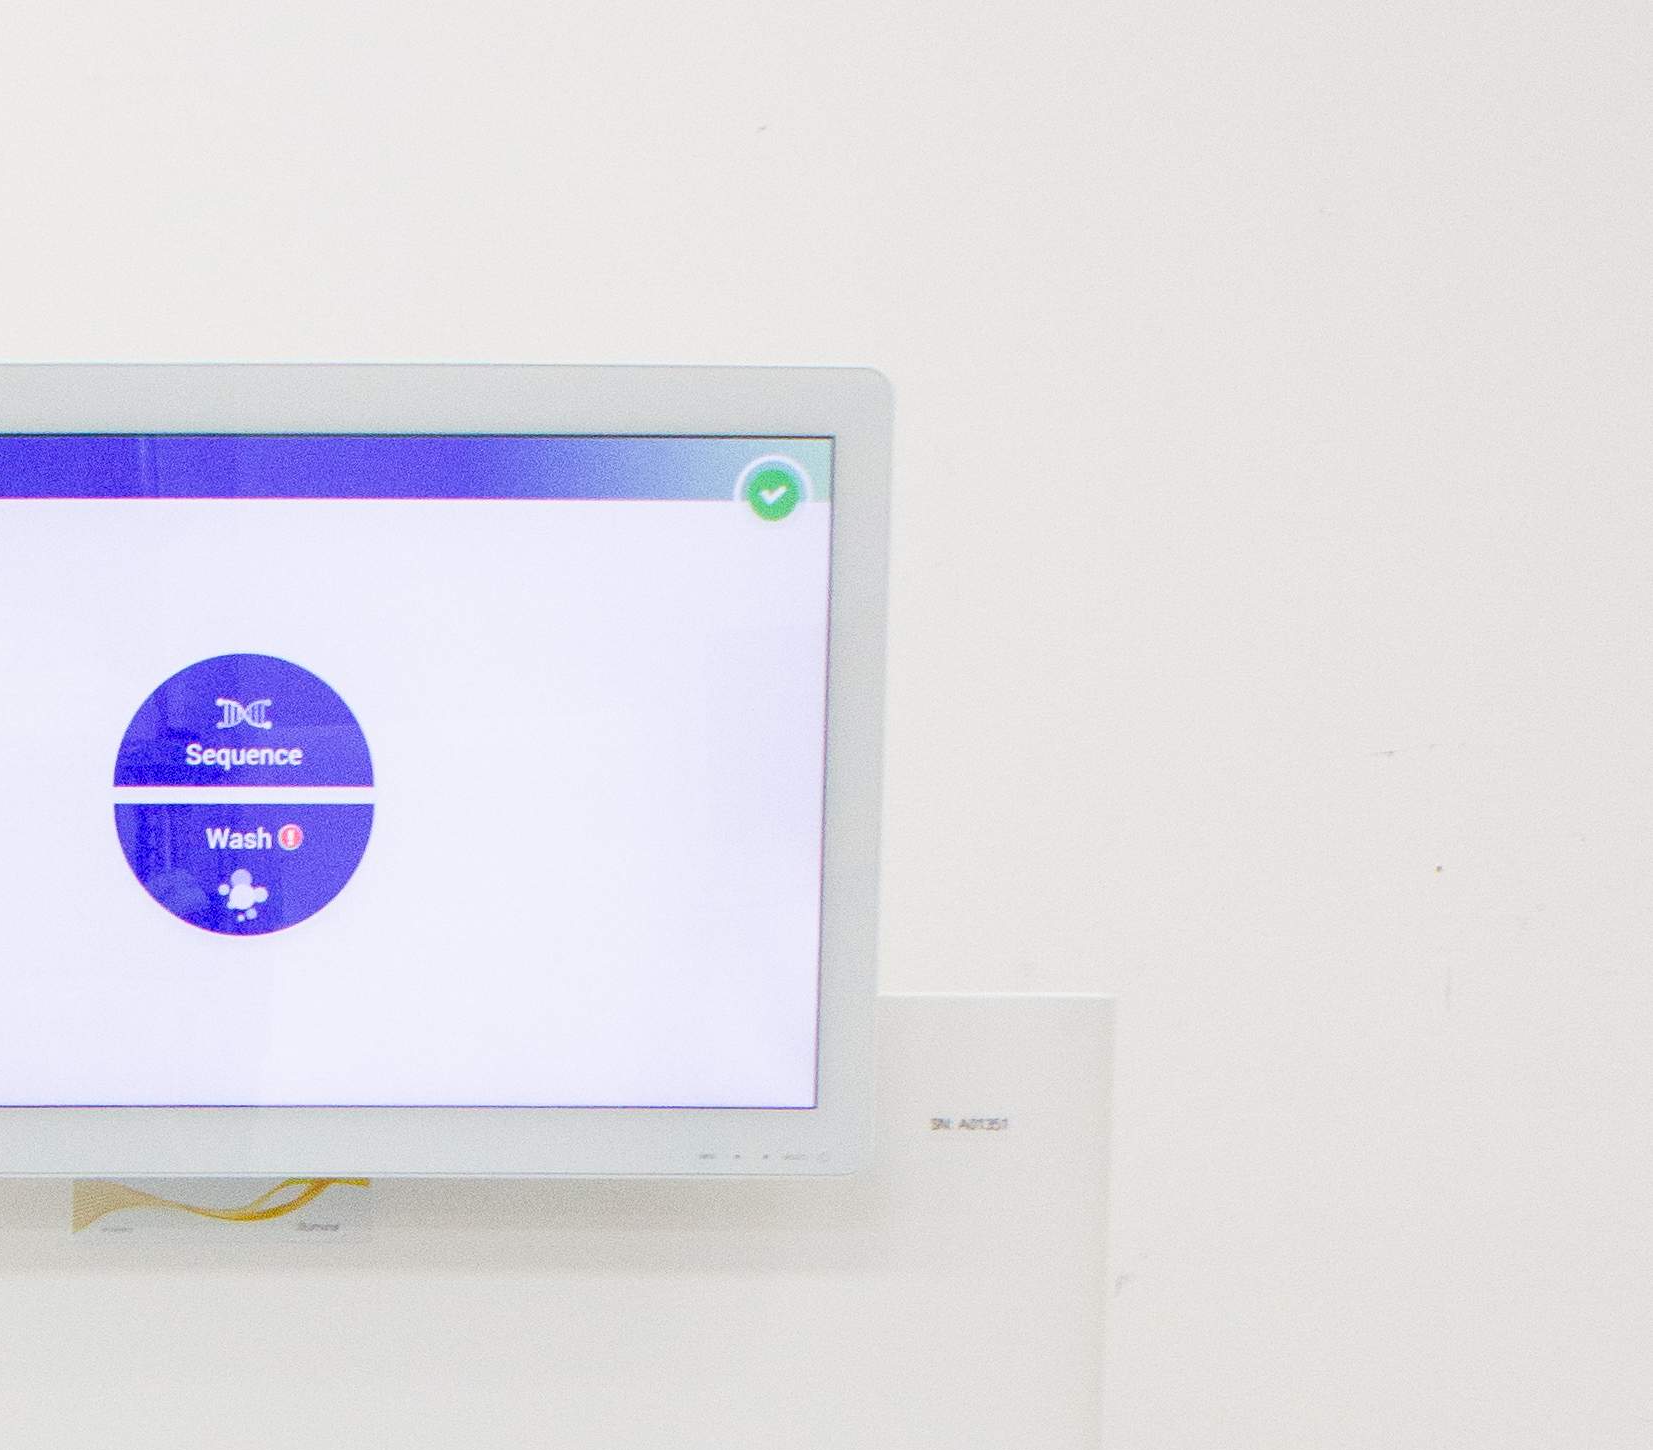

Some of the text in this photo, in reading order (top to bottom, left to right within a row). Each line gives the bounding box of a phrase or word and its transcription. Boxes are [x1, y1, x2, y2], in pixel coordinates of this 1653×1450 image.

[185, 742, 304, 771] Sequence
[205, 826, 273, 850] Wash
[957, 1117, 1009, 1132] A01351
